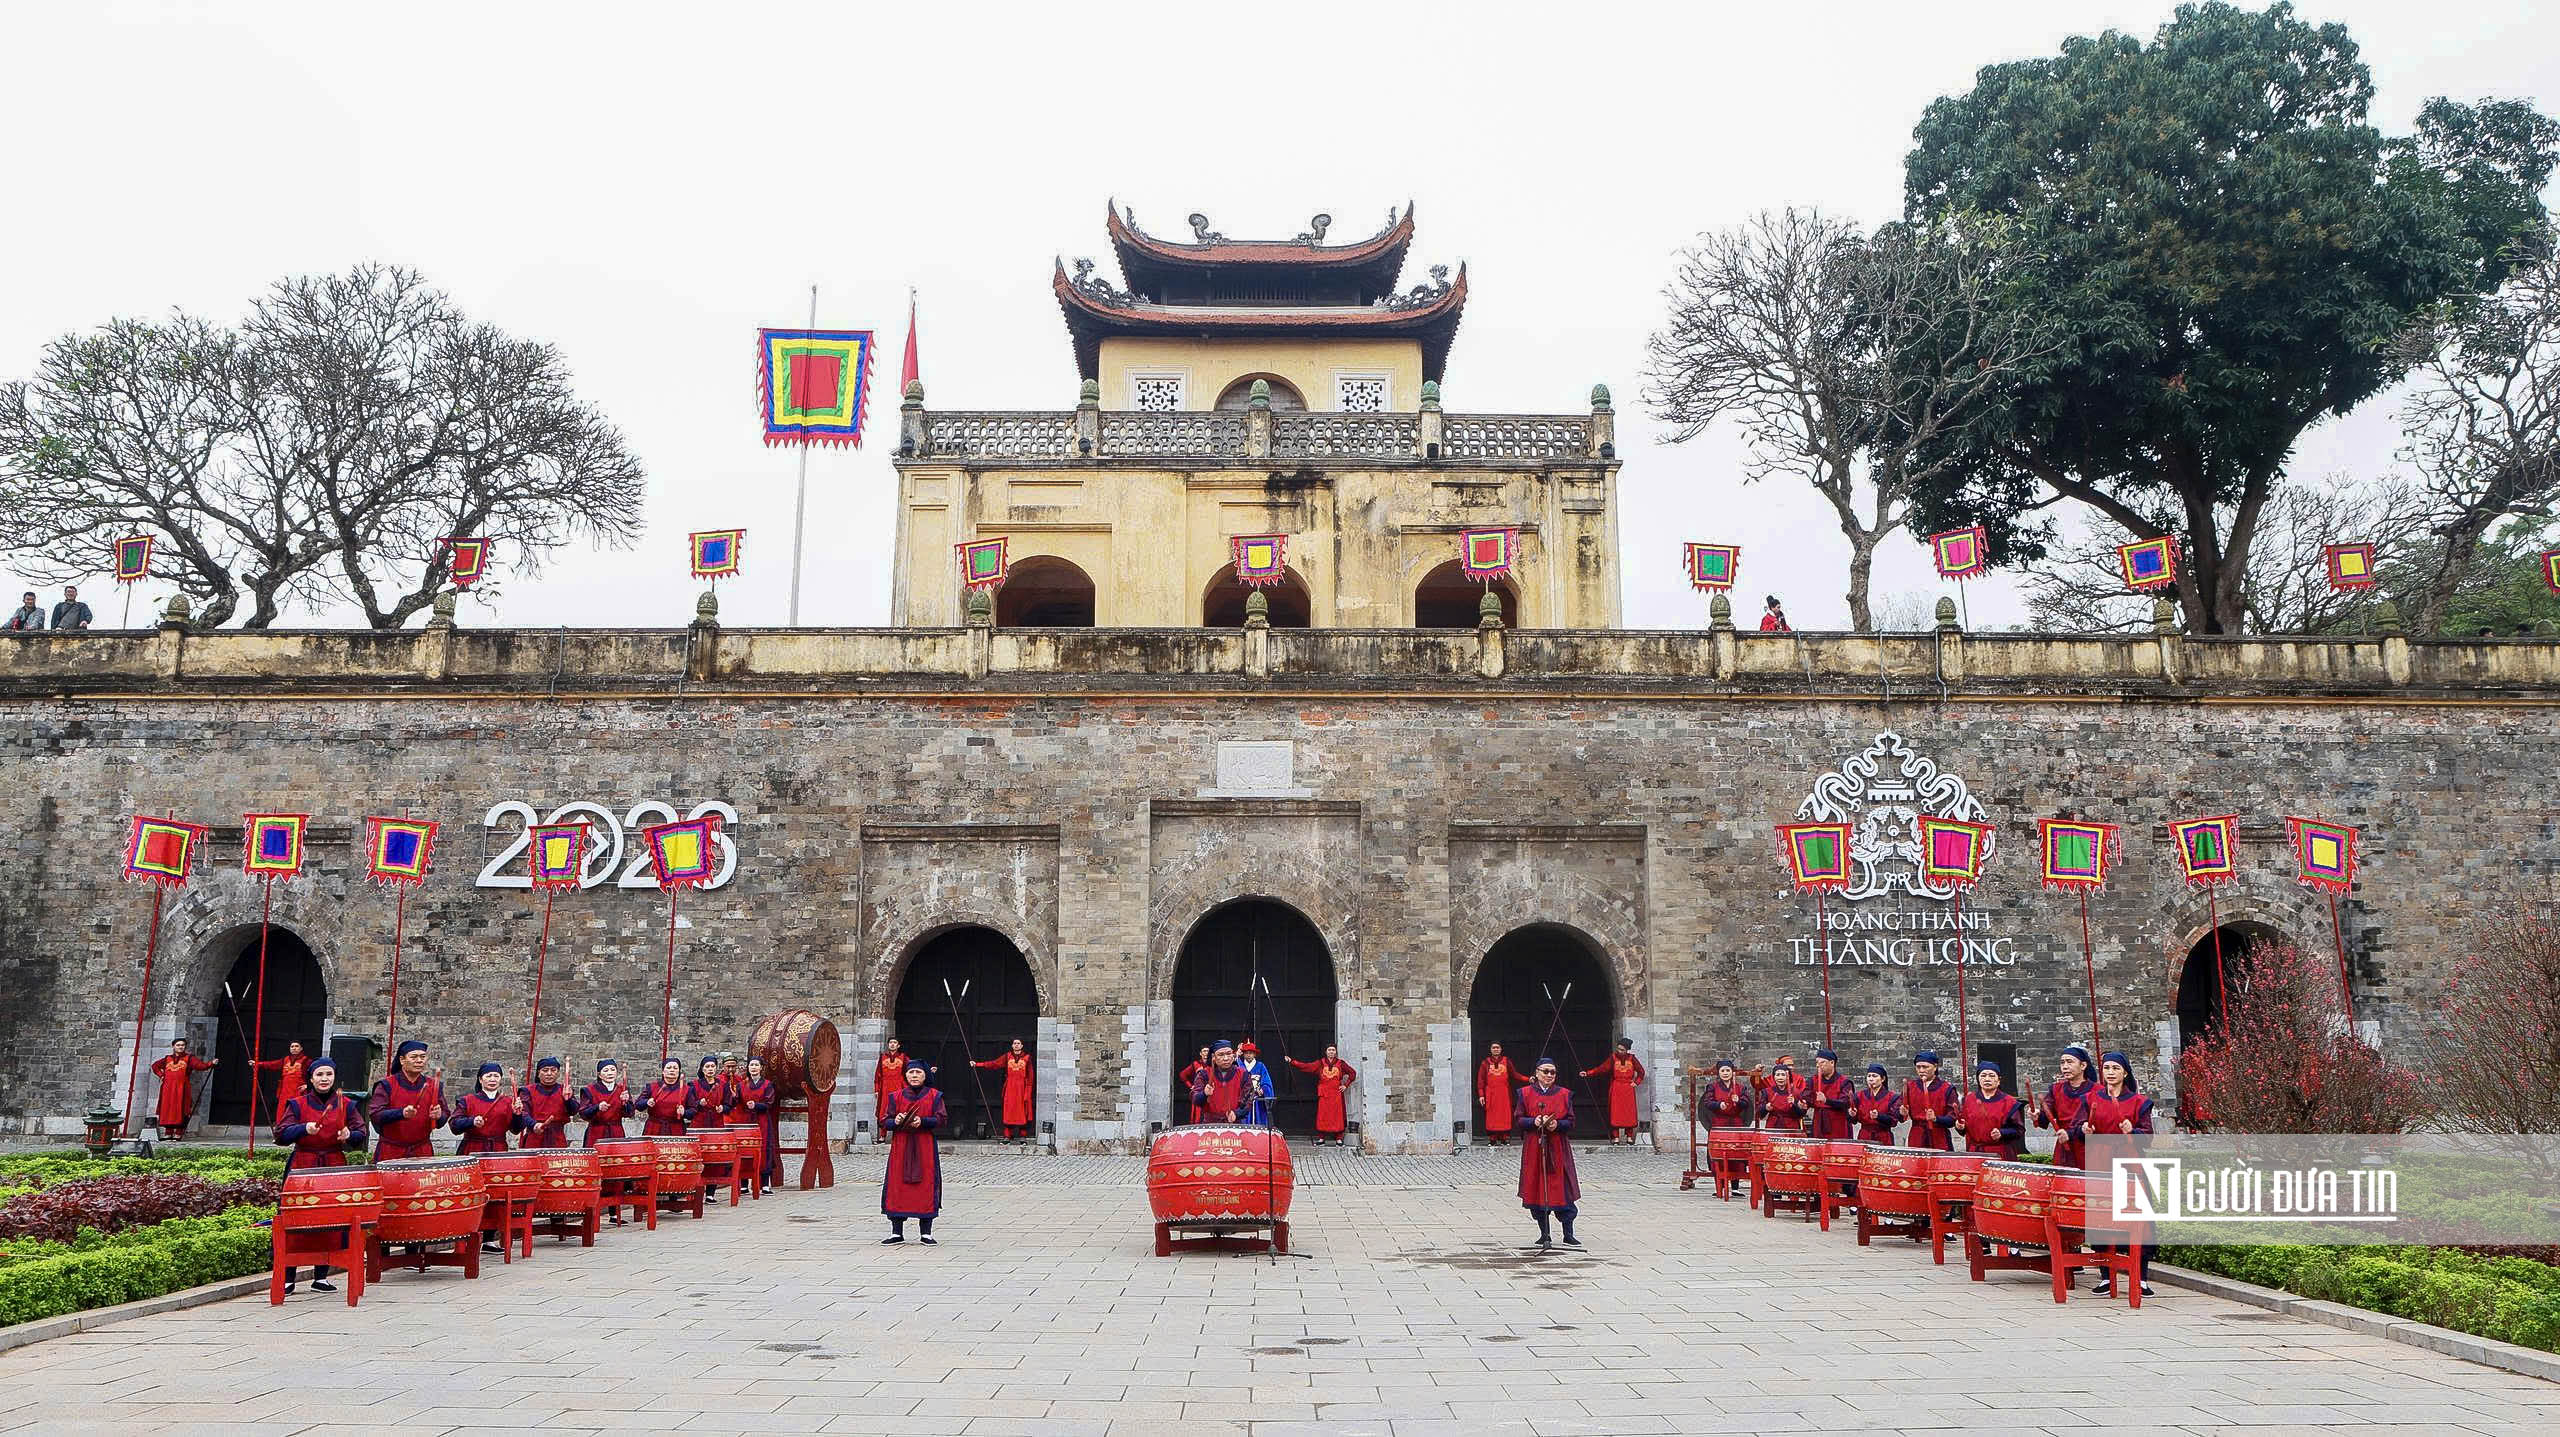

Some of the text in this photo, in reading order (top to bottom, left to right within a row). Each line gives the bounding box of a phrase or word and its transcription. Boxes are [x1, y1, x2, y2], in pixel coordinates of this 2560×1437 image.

[1815, 907, 1992, 930] HOÀNG THÀNH
[1787, 932, 2017, 966] THĂNG LONG
